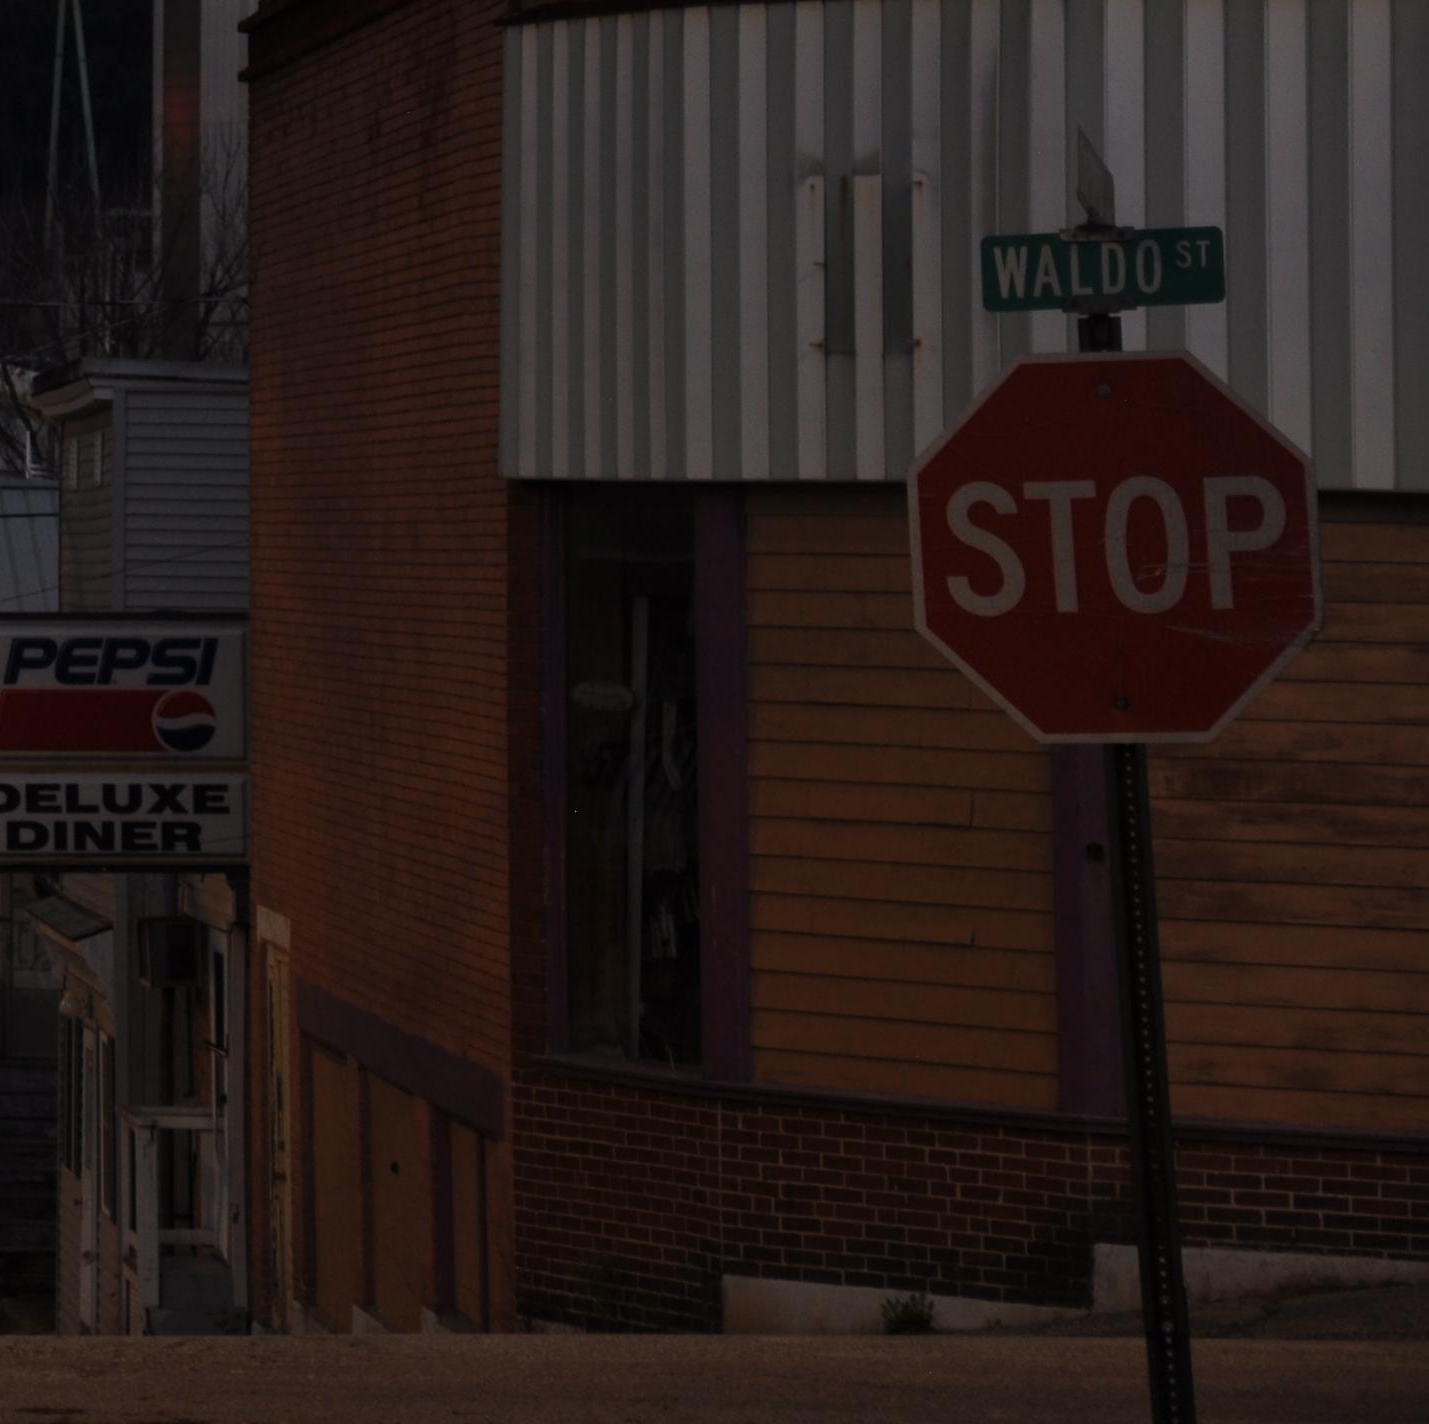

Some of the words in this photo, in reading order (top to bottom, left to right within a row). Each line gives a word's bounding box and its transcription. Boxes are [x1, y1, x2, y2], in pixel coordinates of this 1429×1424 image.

[993, 238, 1163, 300] WALDO
[1175, 238, 1212, 269] ST
[945, 475, 1287, 618] STOP
[3, 637, 219, 685] PEPSI
[7, 821, 202, 851] DINER
